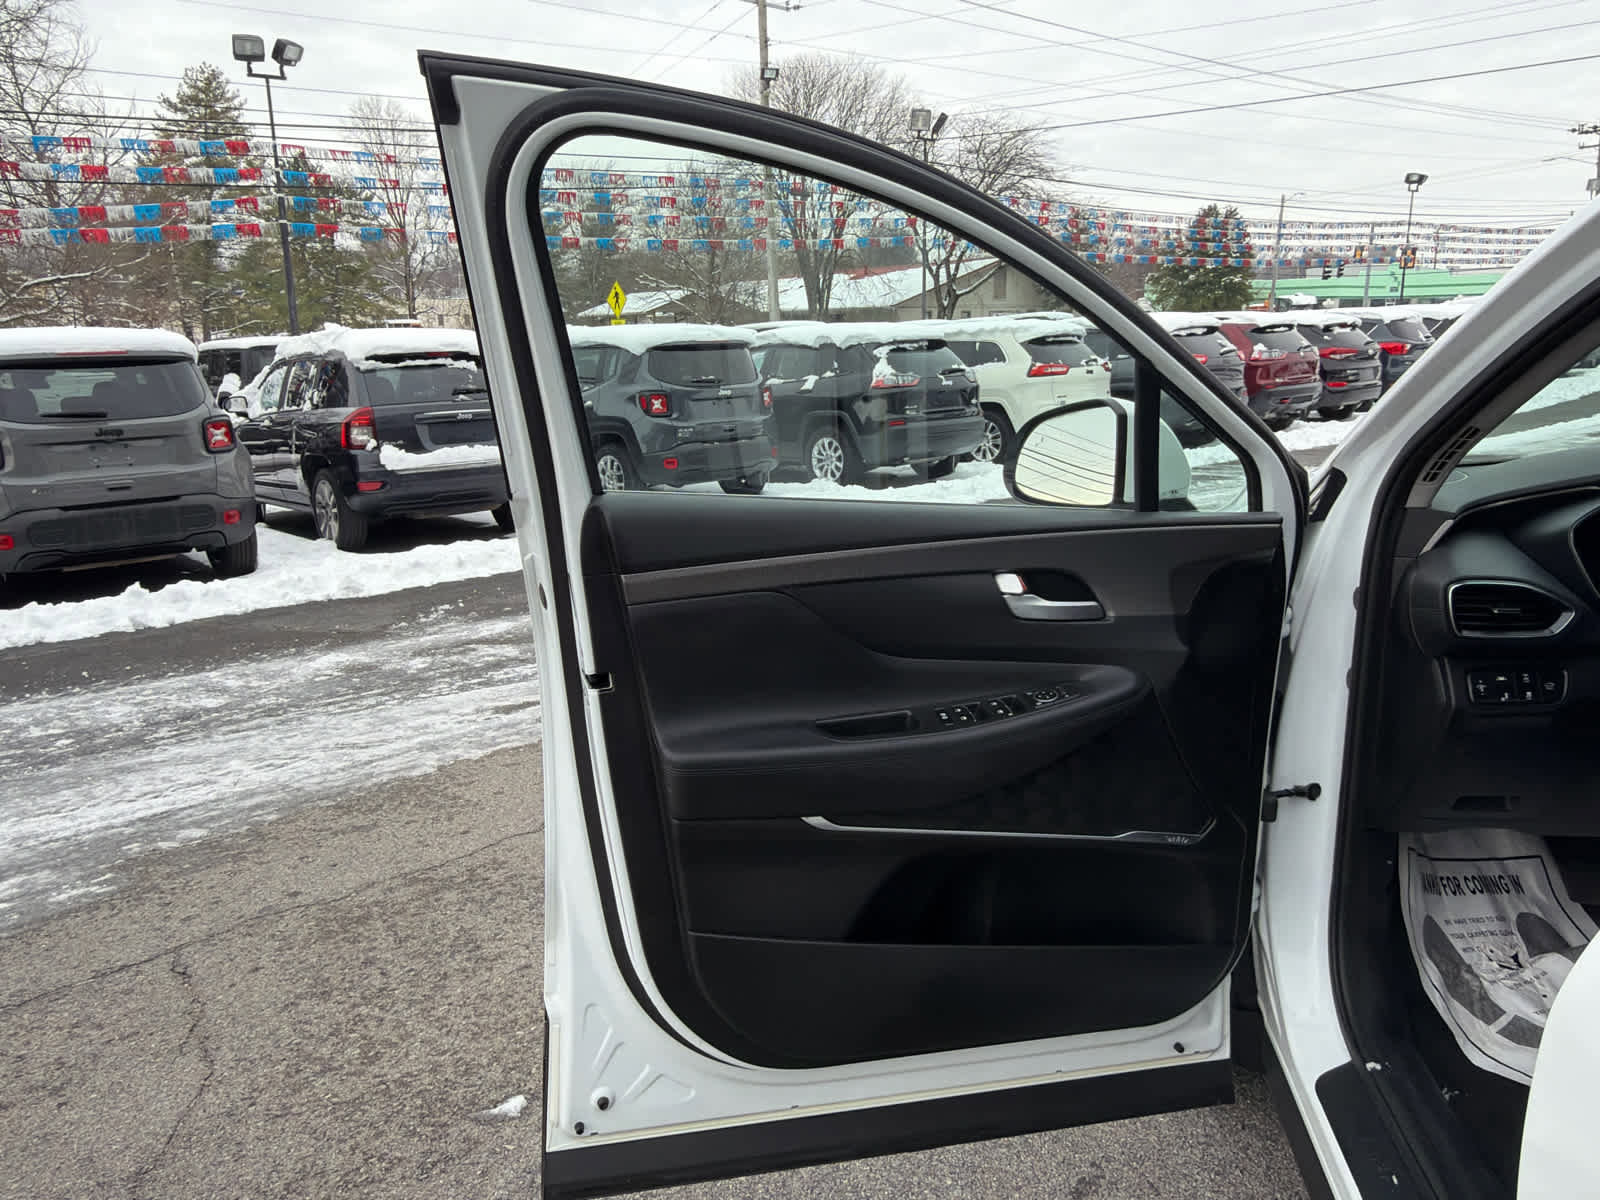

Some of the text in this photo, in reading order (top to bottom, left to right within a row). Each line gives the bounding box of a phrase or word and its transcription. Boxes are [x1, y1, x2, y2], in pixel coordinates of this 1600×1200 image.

[456, 412, 473, 421] Jeep
[94, 427, 124, 438] Jeep
[1439, 875, 1466, 896] FOR
